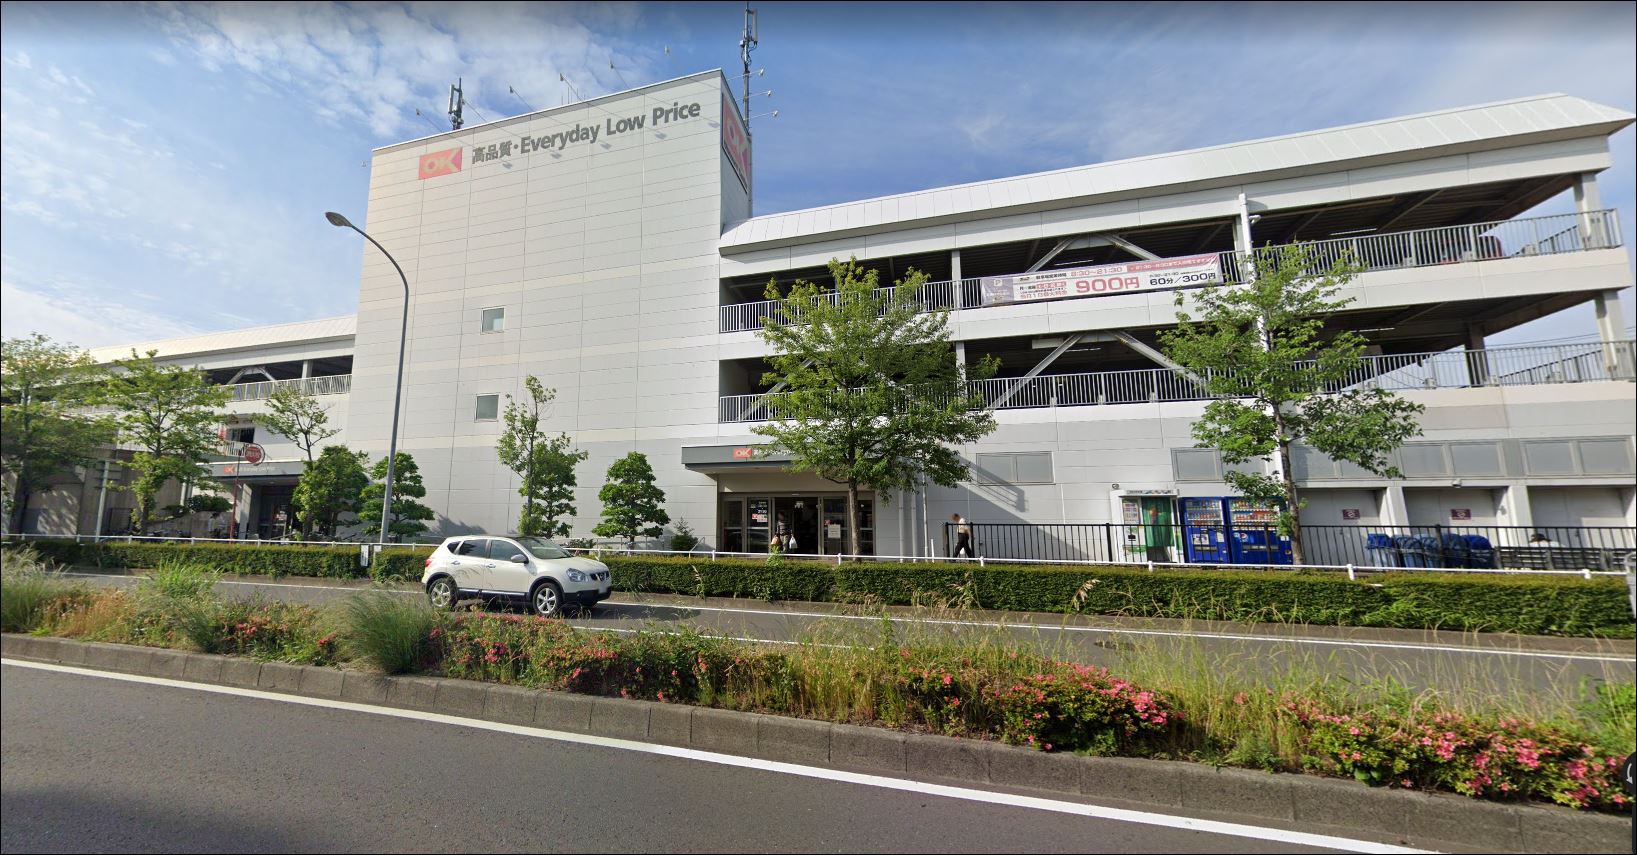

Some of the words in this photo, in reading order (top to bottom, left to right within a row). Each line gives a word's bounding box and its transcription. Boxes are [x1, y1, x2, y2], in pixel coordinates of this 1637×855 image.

[607, 113, 646, 136] Low
[652, 102, 701, 126] Price
[423, 148, 462, 175] OK
[1075, 276, 1139, 293] 900円
[736, 447, 752, 458] OK
